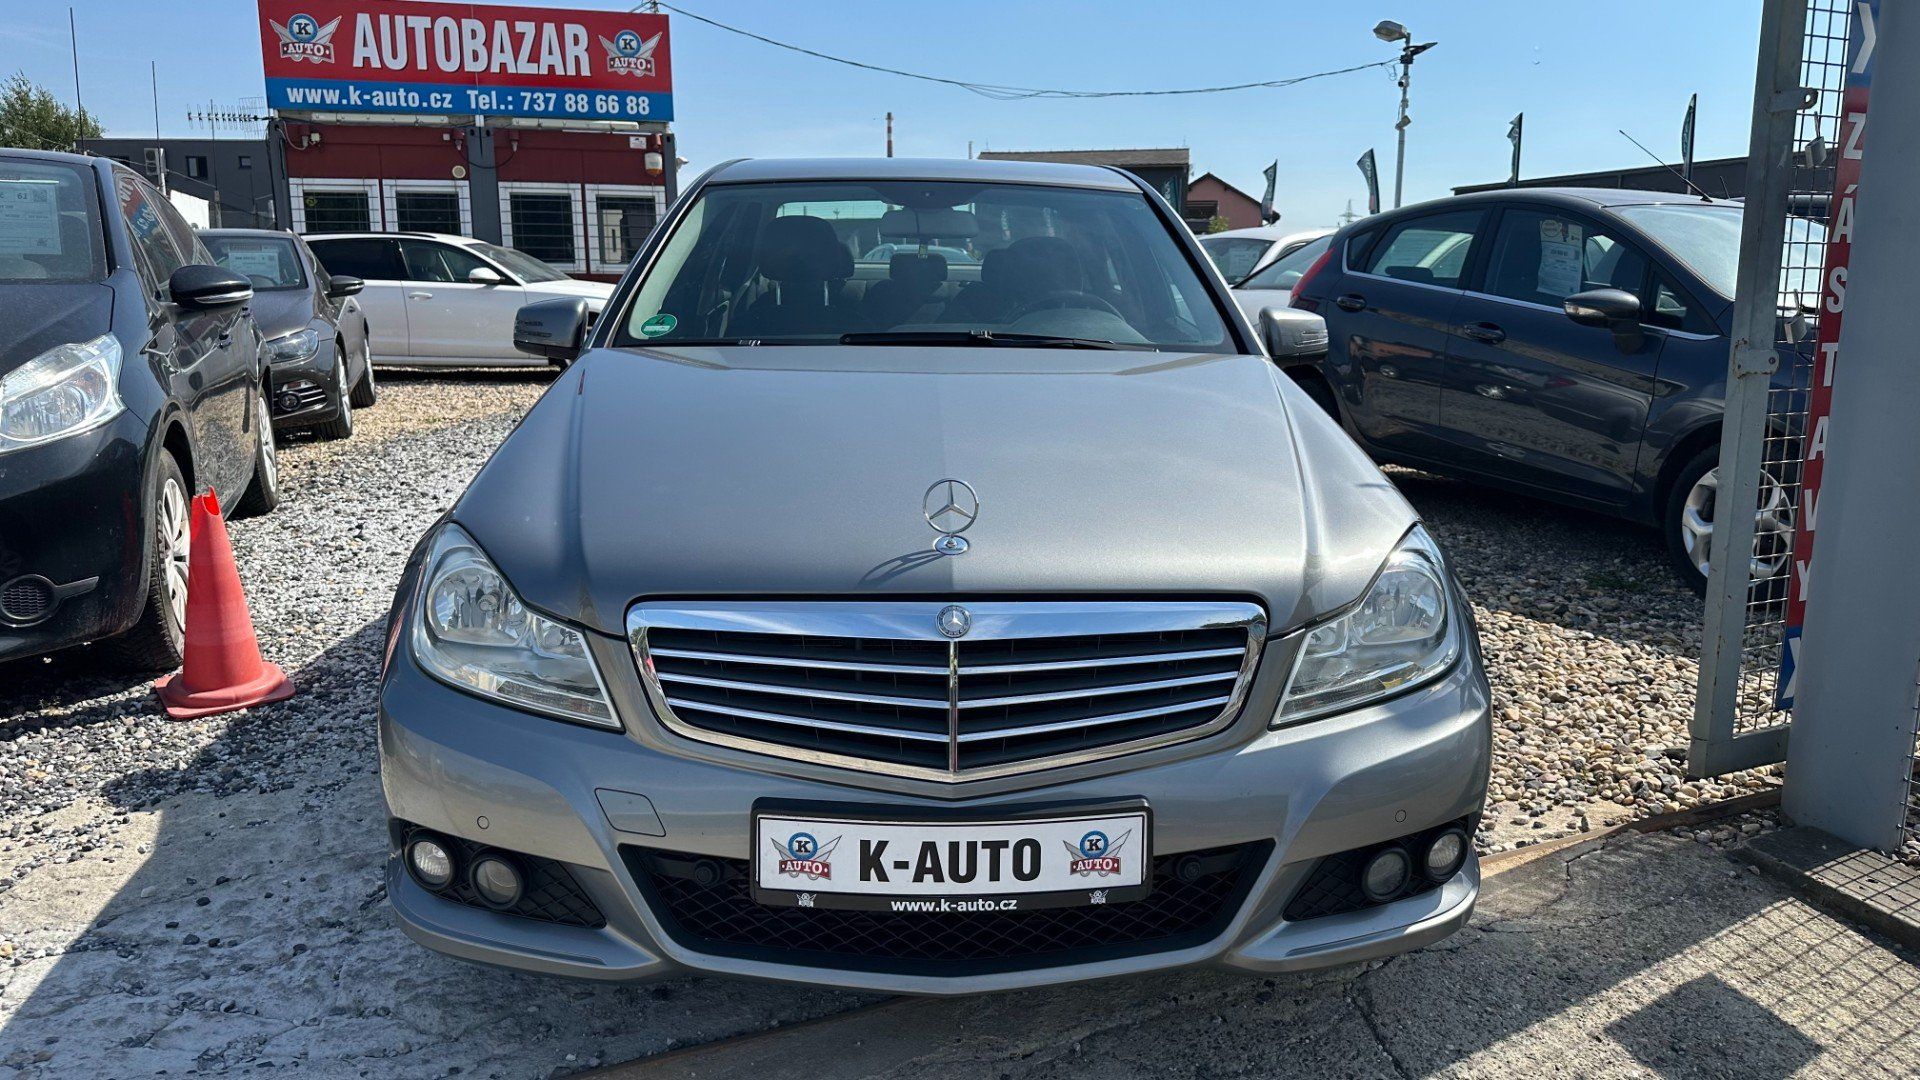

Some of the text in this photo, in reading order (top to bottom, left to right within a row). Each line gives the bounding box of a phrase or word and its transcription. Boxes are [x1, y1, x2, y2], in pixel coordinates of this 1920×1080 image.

[295, 22, 311, 35] K
[287, 43, 325, 56] AUTO
[352, 13, 592, 77] AUTOBAZAR
[622, 38, 635, 50] K
[613, 57, 647, 70] AUTO
[286, 85, 453, 108] www.k-auto.cz
[466, 89, 650, 115] Tel.: 737 88 66 88
[795, 840, 811, 853] K
[1087, 838, 1102, 851] K
[785, 860, 823, 874] AUTO
[859, 837, 1042, 884] K-AUTO
[1076, 858, 1113, 871] AUTO
[890, 898, 1018, 912] www.k-auto.cz
